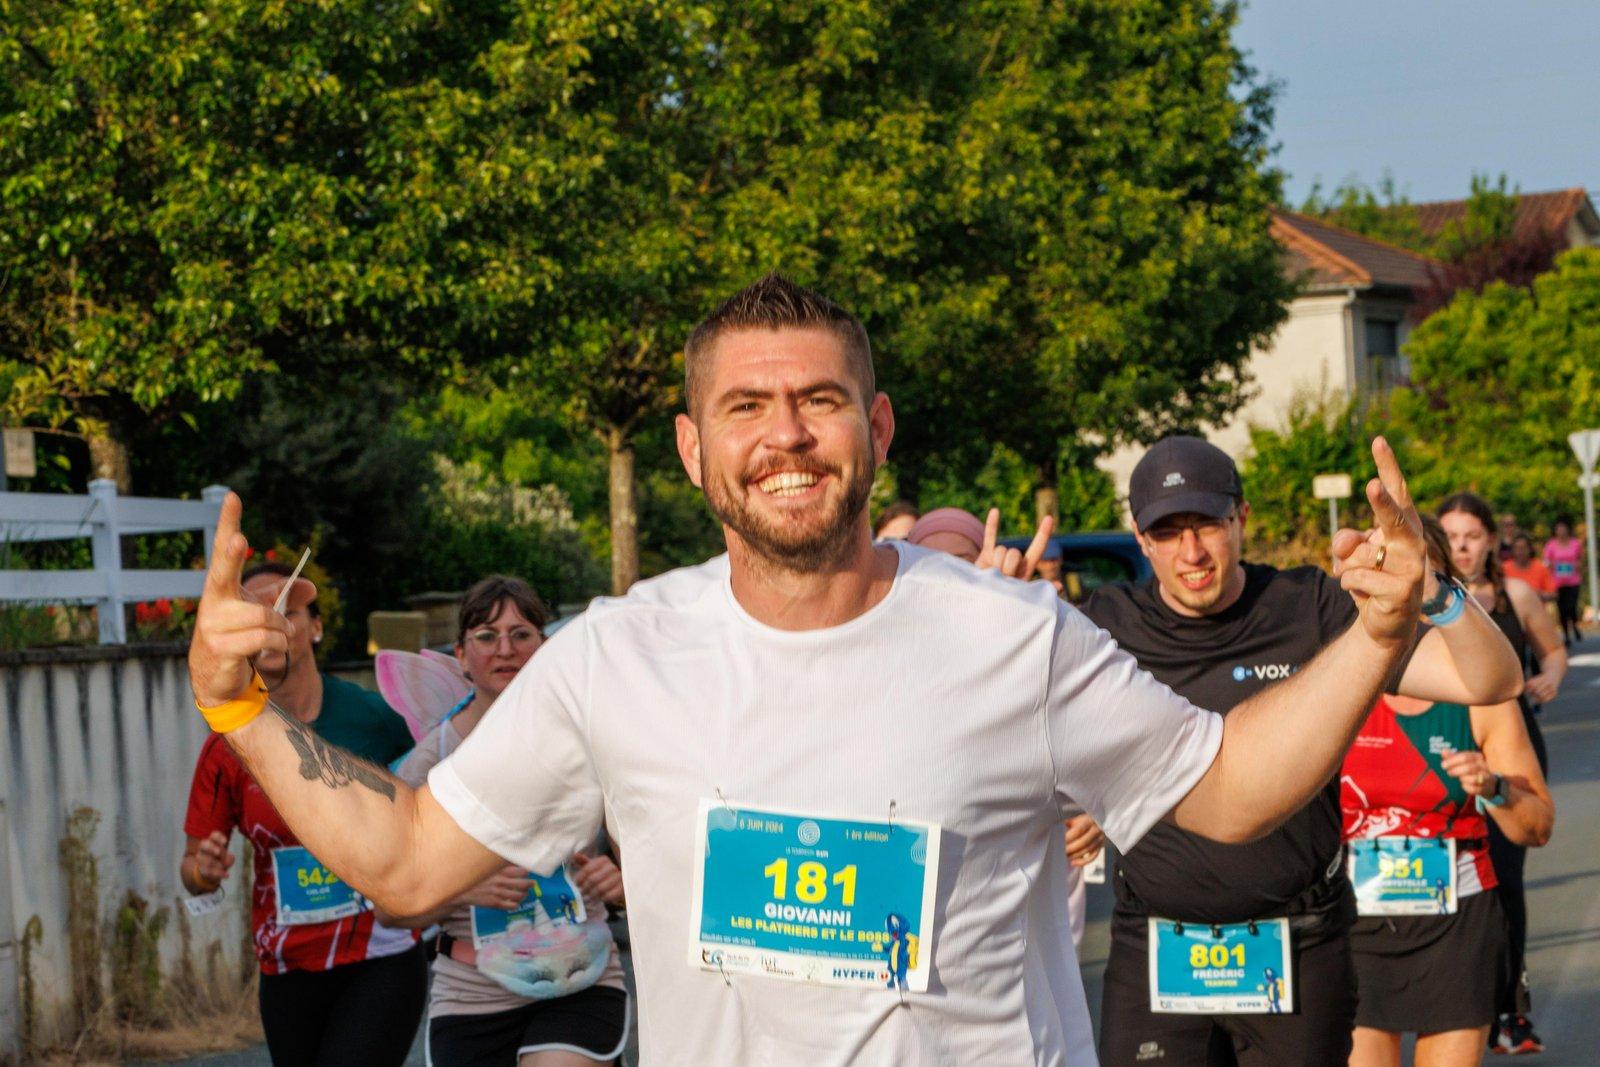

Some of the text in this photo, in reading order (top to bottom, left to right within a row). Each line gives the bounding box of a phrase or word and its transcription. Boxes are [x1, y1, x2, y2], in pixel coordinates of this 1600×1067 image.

[1254, 664, 1290, 680] VOX
[764, 858, 858, 906] 181
[764, 902, 852, 926] GIOVANNI
[731, 915, 753, 930] LES
[821, 927, 837, 941] ET
[840, 928, 855, 942] LE
[1189, 943, 1246, 968] 801
[833, 968, 876, 980] HYPER
